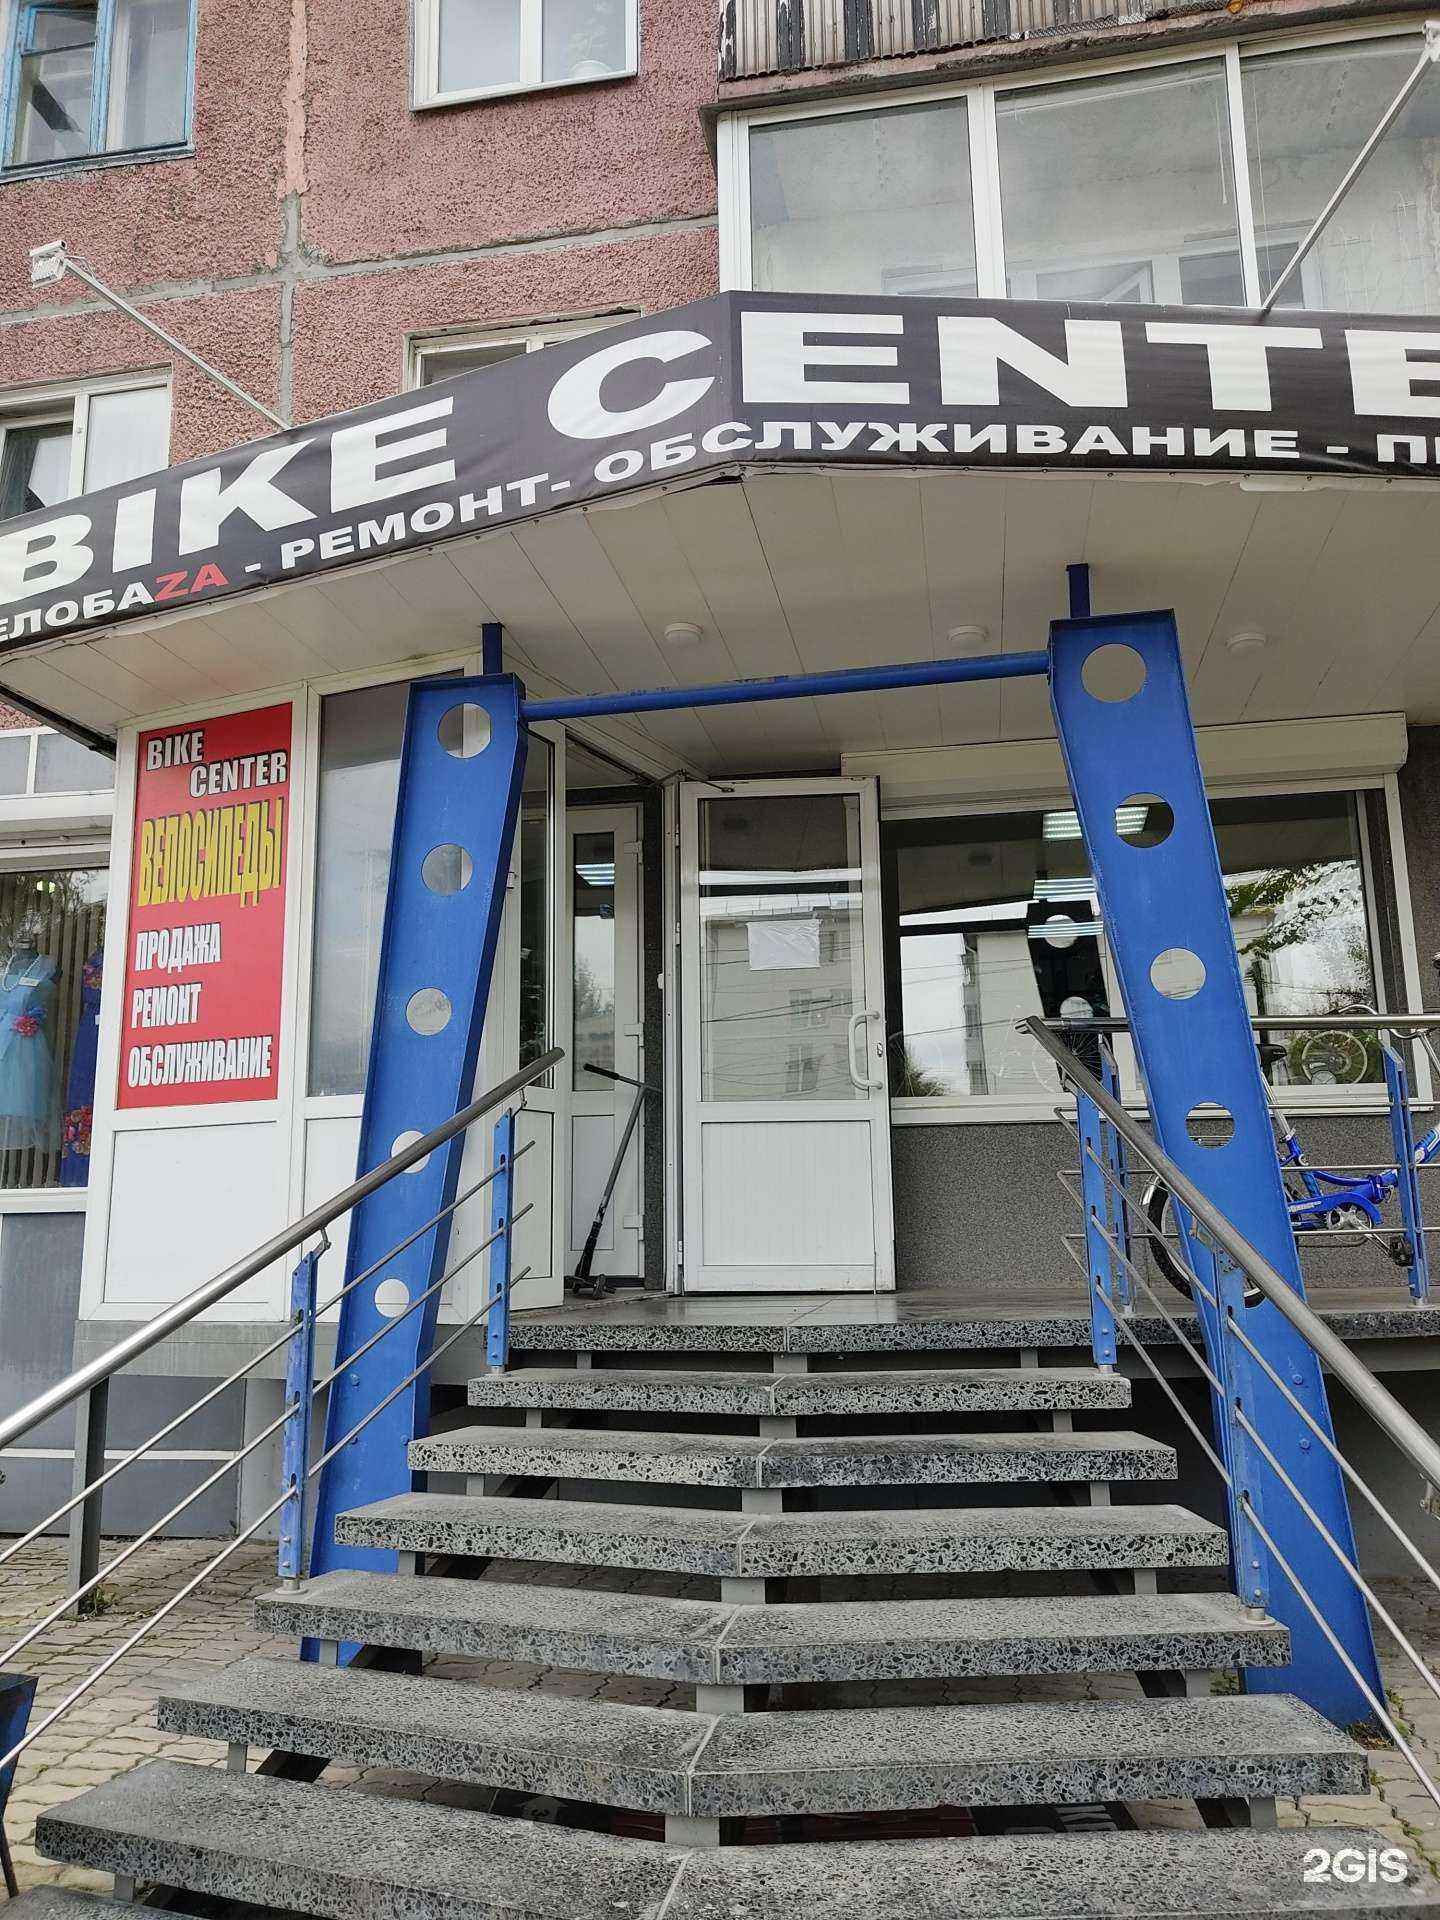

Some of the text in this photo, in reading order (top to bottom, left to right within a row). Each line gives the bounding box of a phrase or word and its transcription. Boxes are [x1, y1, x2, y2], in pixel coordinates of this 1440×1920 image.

[0, 397, 456, 605] BIKE
[0, 563, 229, 642] ЛОБАZA
[594, 421, 1300, 483] ОБСЛУЖИВАНИЕ
[146, 730, 204, 771] BIKE
[189, 751, 288, 798] CENTER
[137, 797, 285, 908] ВЕЛОСИПЕДЫ
[135, 922, 222, 974] ПРОДАЖА
[131, 982, 202, 1029] РЕМОНТ
[128, 1035, 273, 1087] ОБСЛУЖИВАНИЕ
